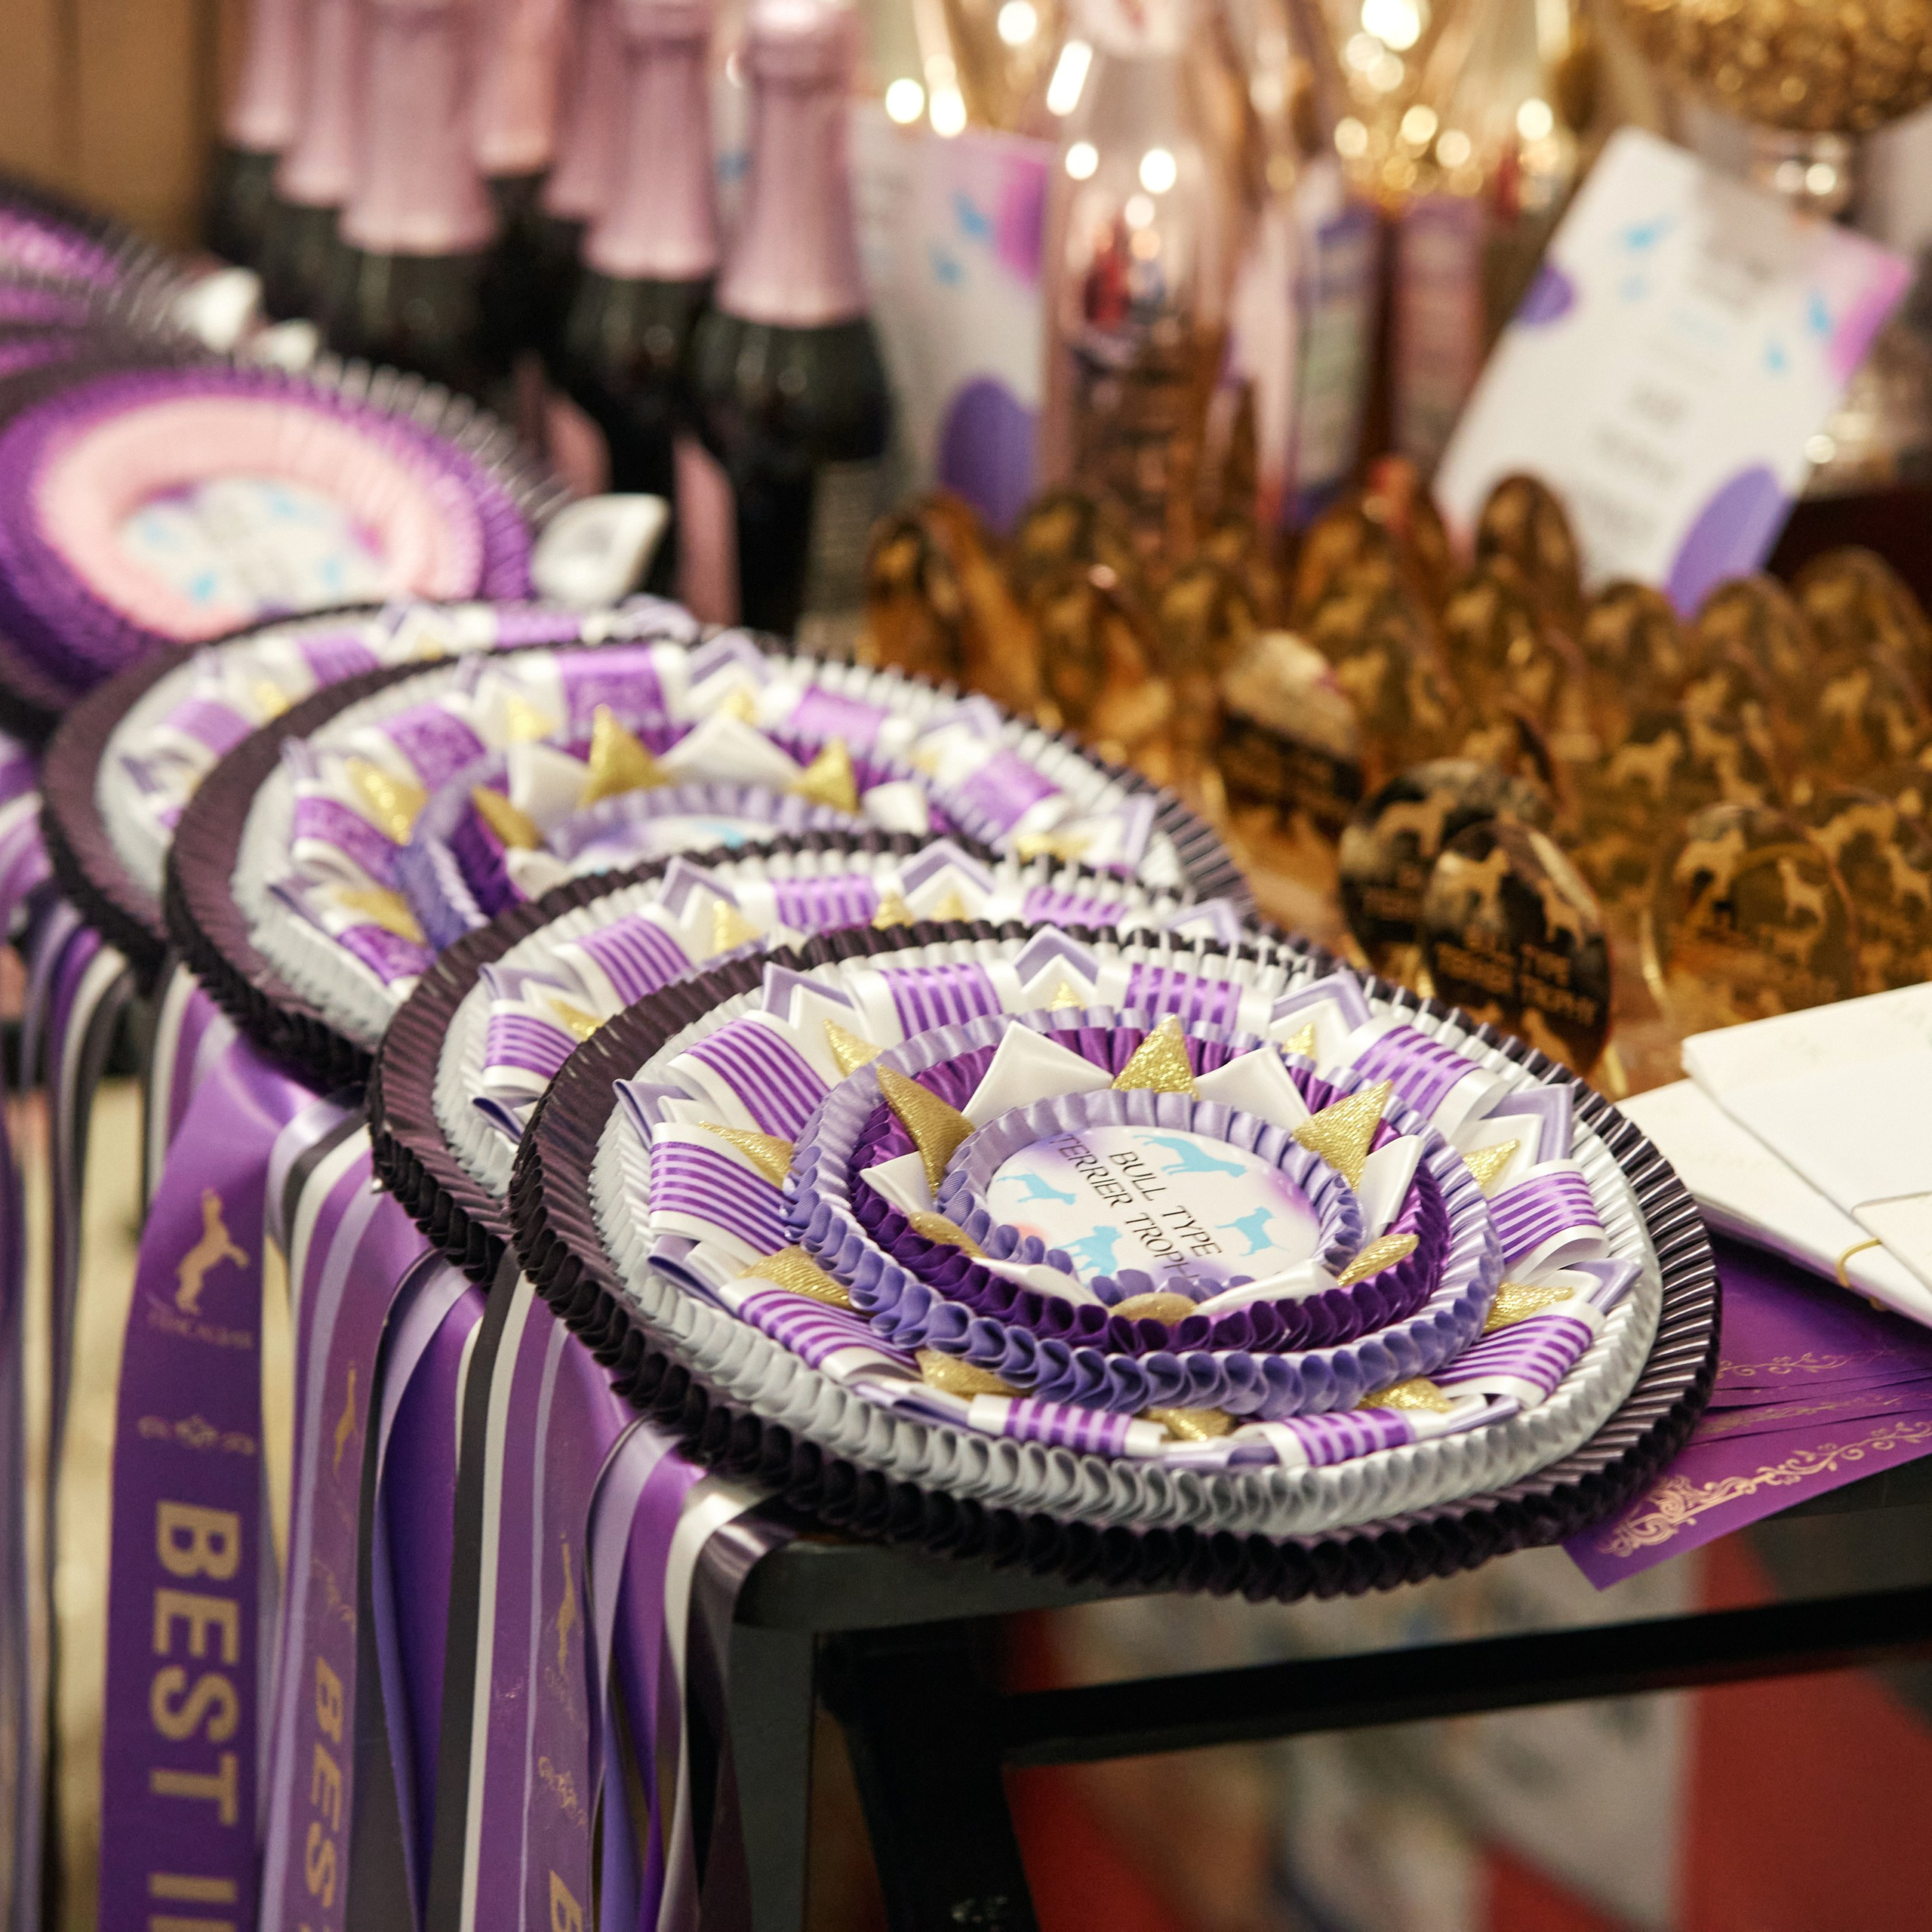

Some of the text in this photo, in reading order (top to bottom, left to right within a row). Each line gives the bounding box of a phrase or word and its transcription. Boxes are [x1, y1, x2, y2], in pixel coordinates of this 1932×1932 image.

[1049, 1134, 1200, 1278] TERRIER TROPH
[1108, 1151, 1223, 1257] BULL TYPE
[148, 1499, 241, 1829] BEST
[304, 1656, 342, 1932] BES
